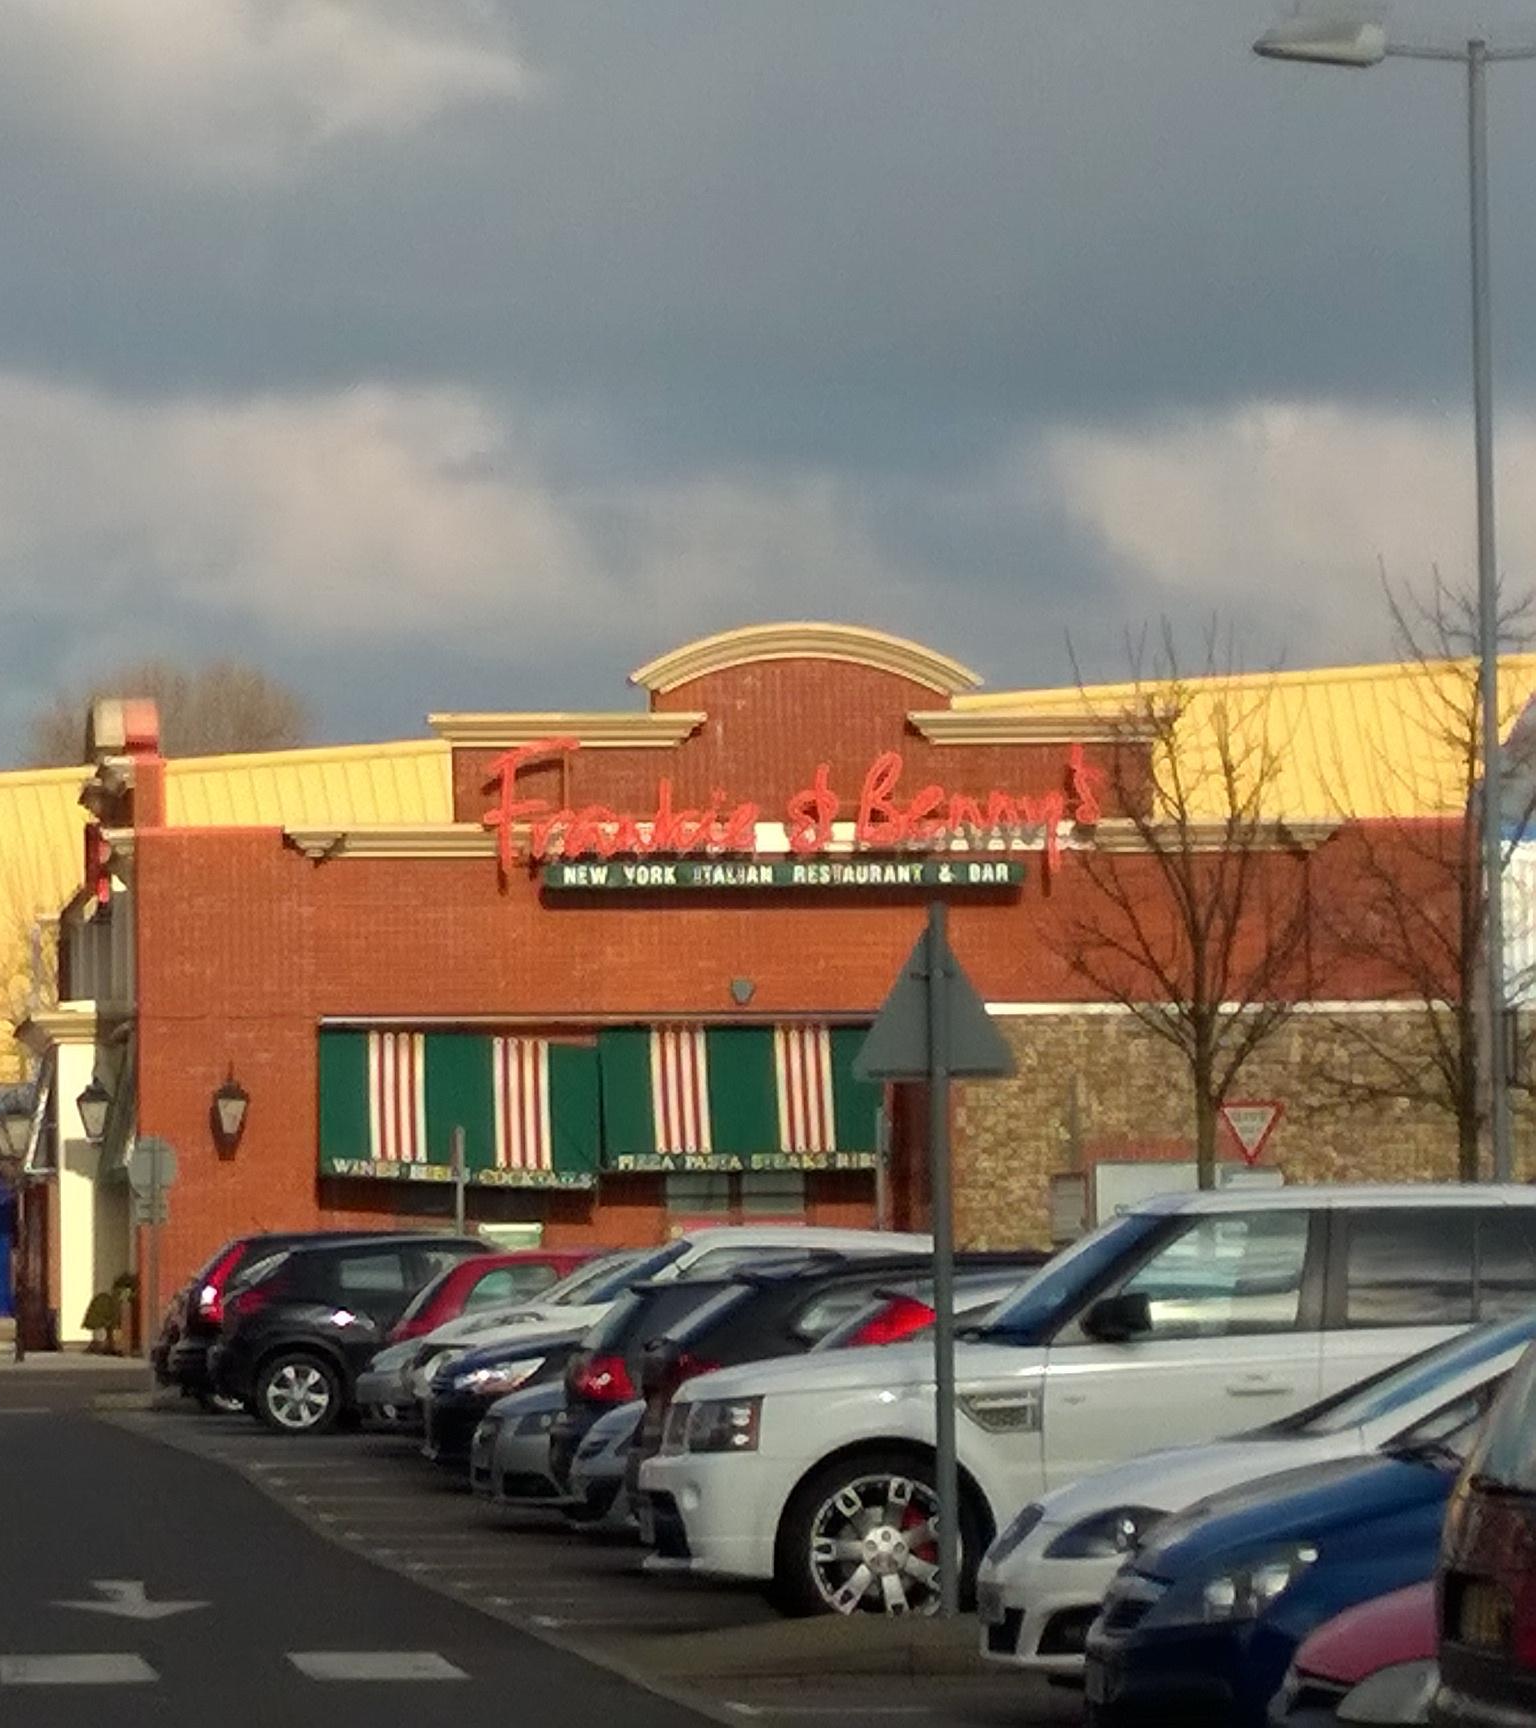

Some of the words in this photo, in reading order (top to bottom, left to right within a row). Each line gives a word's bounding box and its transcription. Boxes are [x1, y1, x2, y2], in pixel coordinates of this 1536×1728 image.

[563, 864, 609, 885] NEW
[622, 864, 677, 885] YORK
[693, 865, 773, 885] ITALIAN
[792, 863, 924, 885] RESTAURANT
[938, 863, 956, 884] &
[968, 862, 1010, 883] BAR
